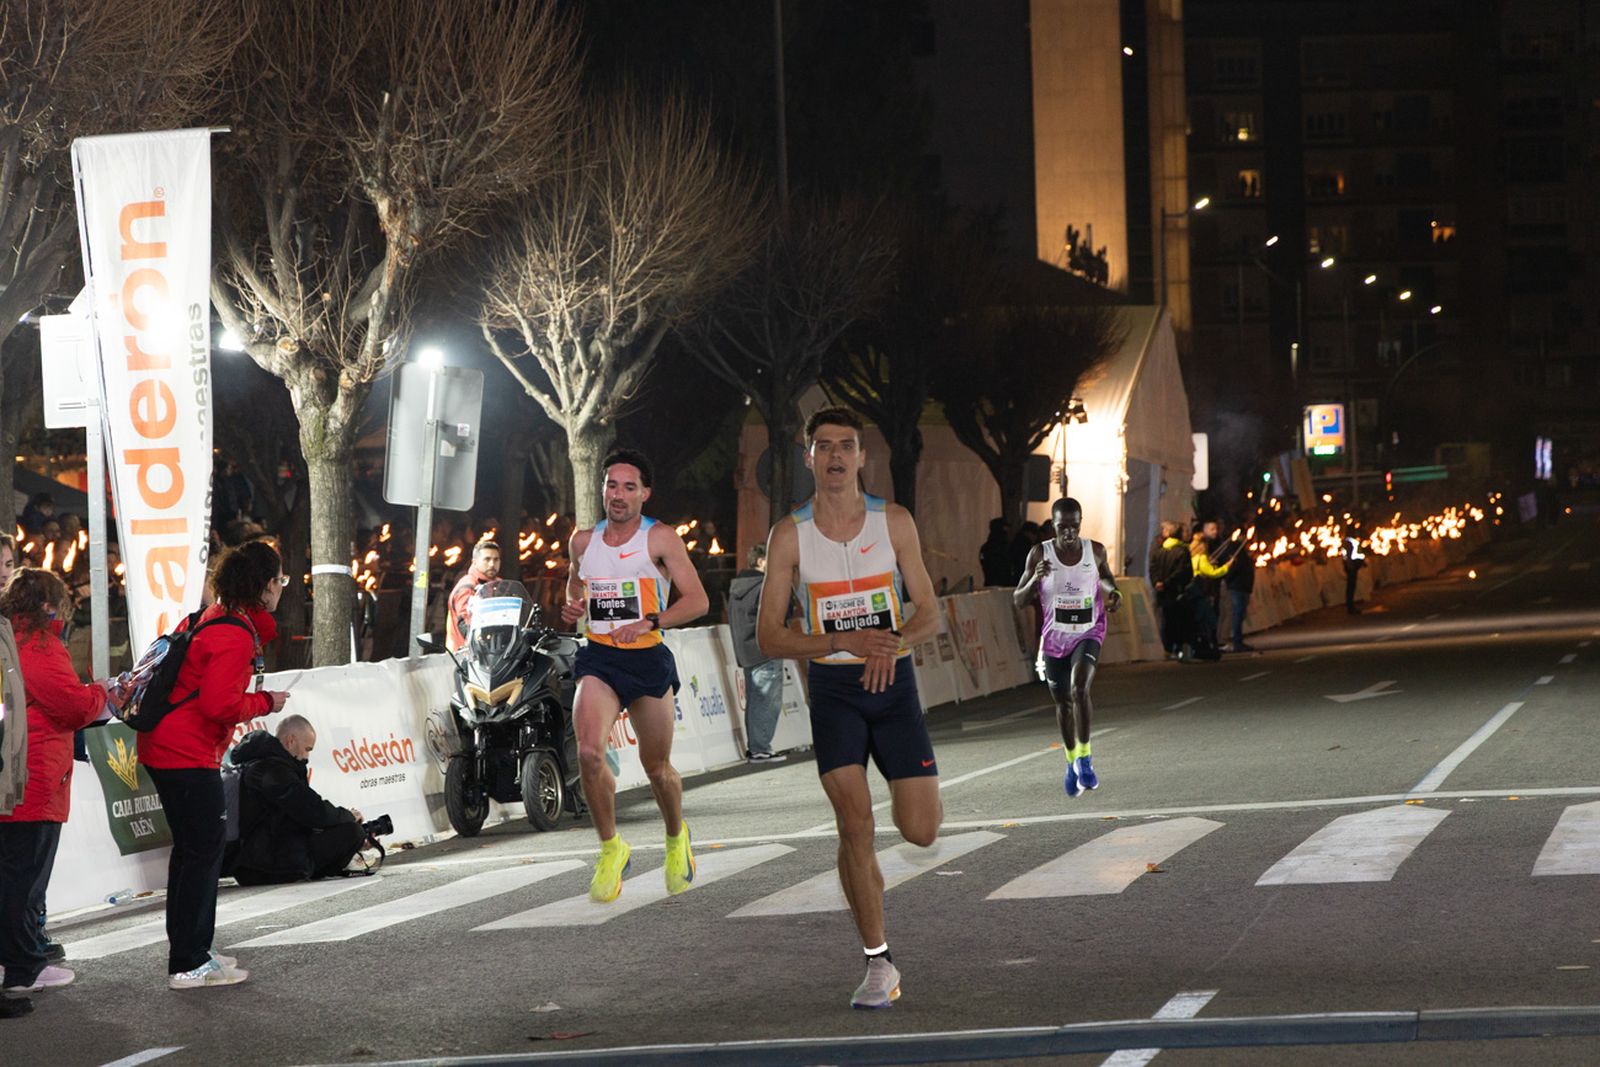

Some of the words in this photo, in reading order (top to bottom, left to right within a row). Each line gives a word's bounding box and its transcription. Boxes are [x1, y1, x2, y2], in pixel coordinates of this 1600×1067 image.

[596, 598, 626, 609] Fontes
[608, 608, 614, 616] 4
[834, 614, 880, 631] Quijada
[332, 733, 416, 774] calderón
[360, 779, 378, 789] obras
[112, 798, 133, 818] CAJA
[134, 794, 163, 813] RURAL
[129, 817, 156, 839] JAÉN
